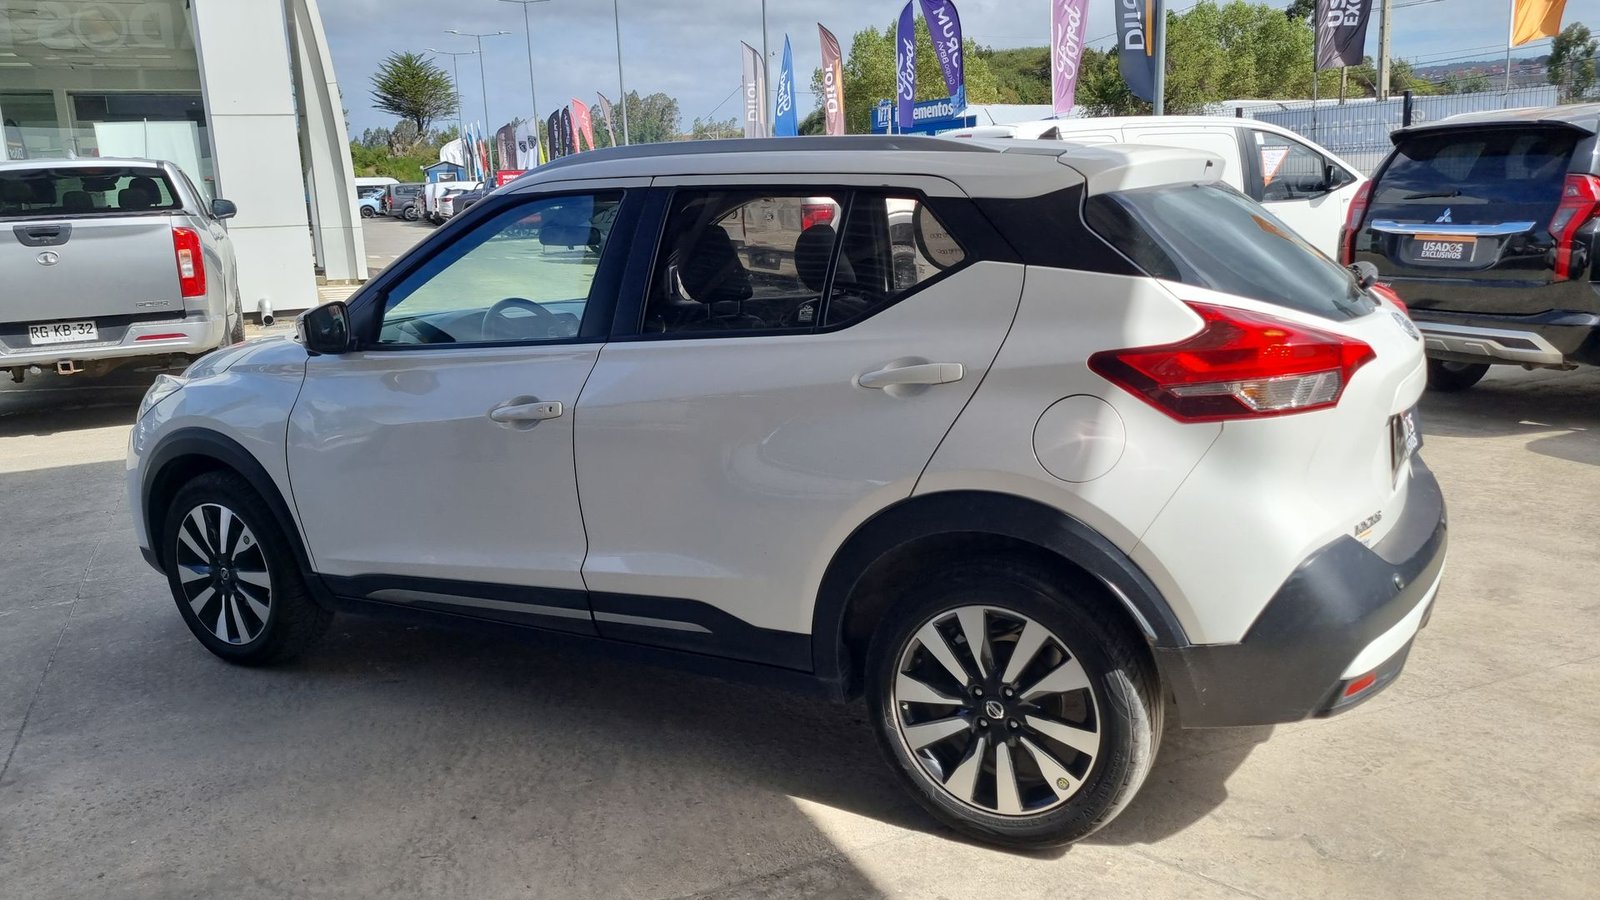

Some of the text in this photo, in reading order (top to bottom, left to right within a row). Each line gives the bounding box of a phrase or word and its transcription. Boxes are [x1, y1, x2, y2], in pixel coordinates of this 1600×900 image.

[1343, 0, 1362, 26] EX
[1055, 4, 1081, 80] Ford
[898, 37, 914, 101] Ford
[1421, 250, 1461, 260] EXCLUSIVOS
[1423, 242, 1463, 253] USADOS
